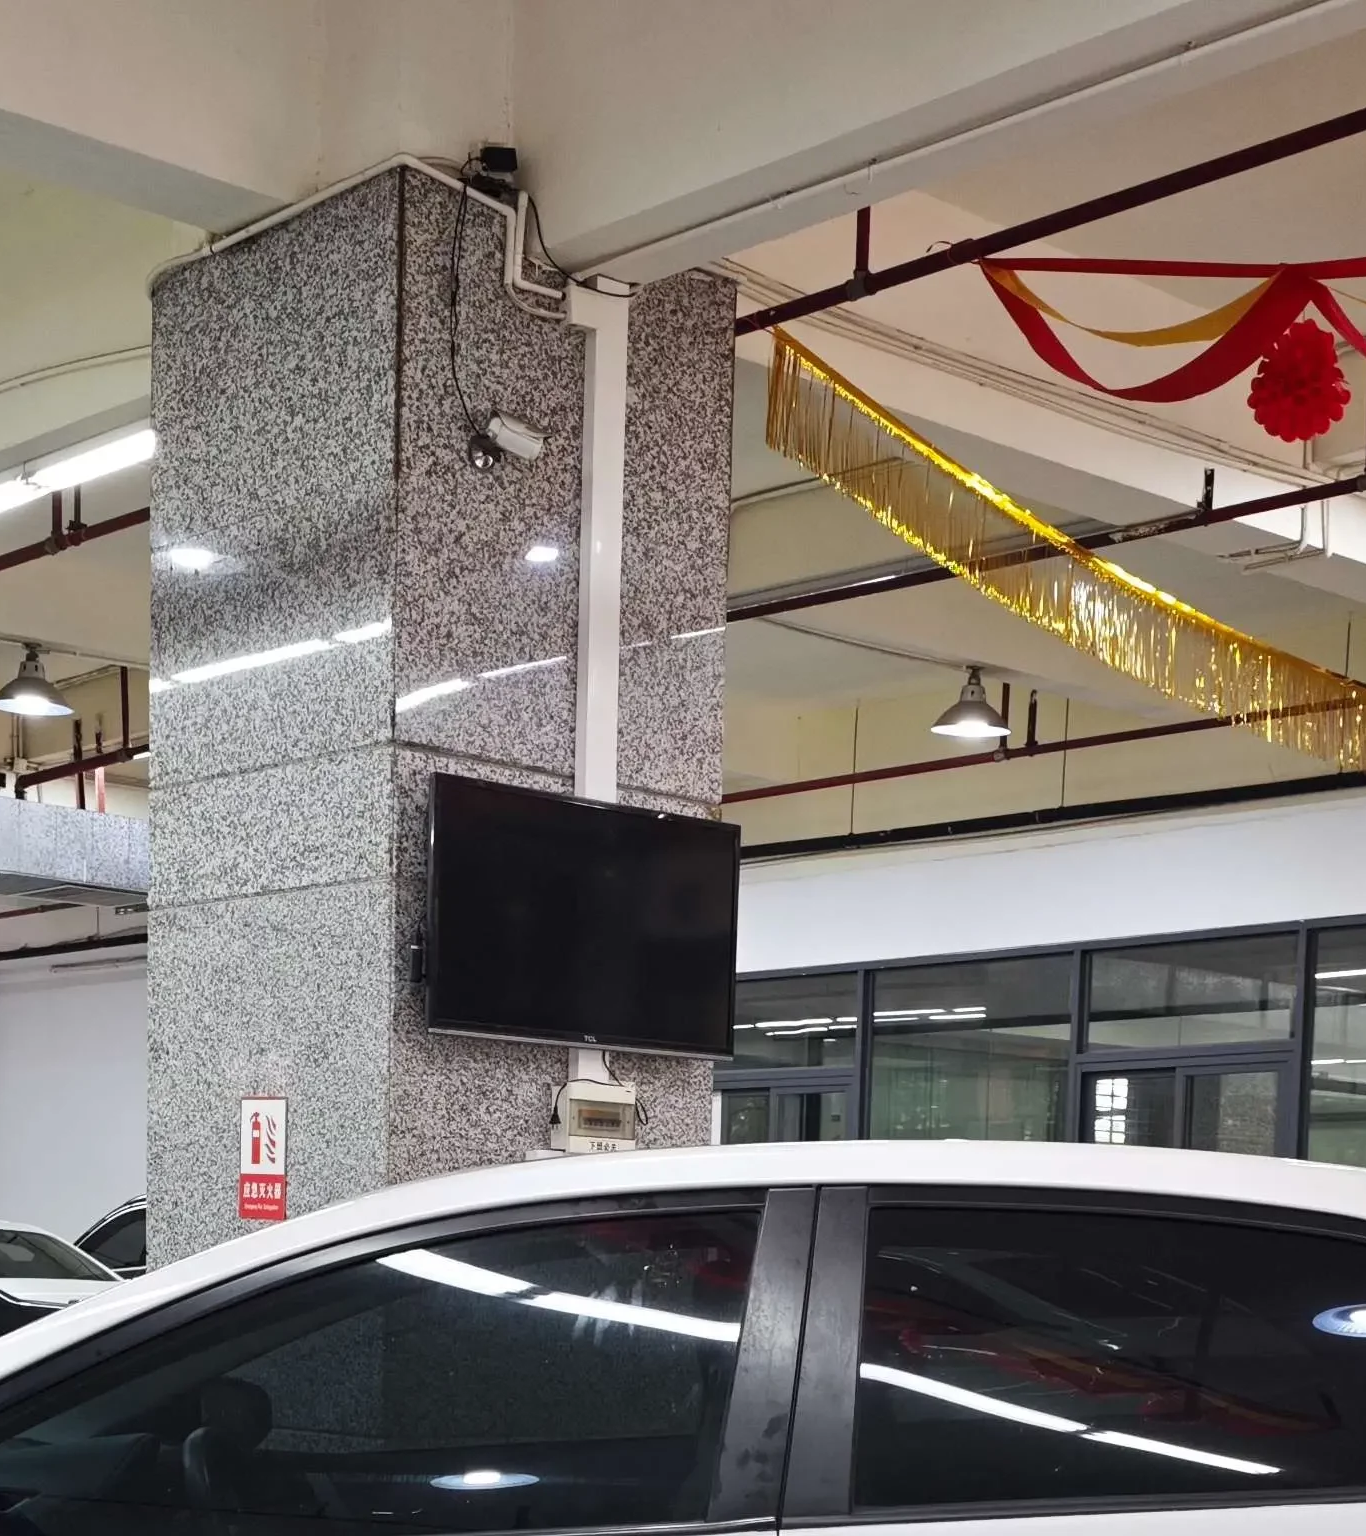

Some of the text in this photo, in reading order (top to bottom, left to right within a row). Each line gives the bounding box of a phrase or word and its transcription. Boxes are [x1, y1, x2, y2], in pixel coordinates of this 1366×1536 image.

[584, 1034, 597, 1042] TCL
[243, 1182, 282, 1199] 应急灭火器
